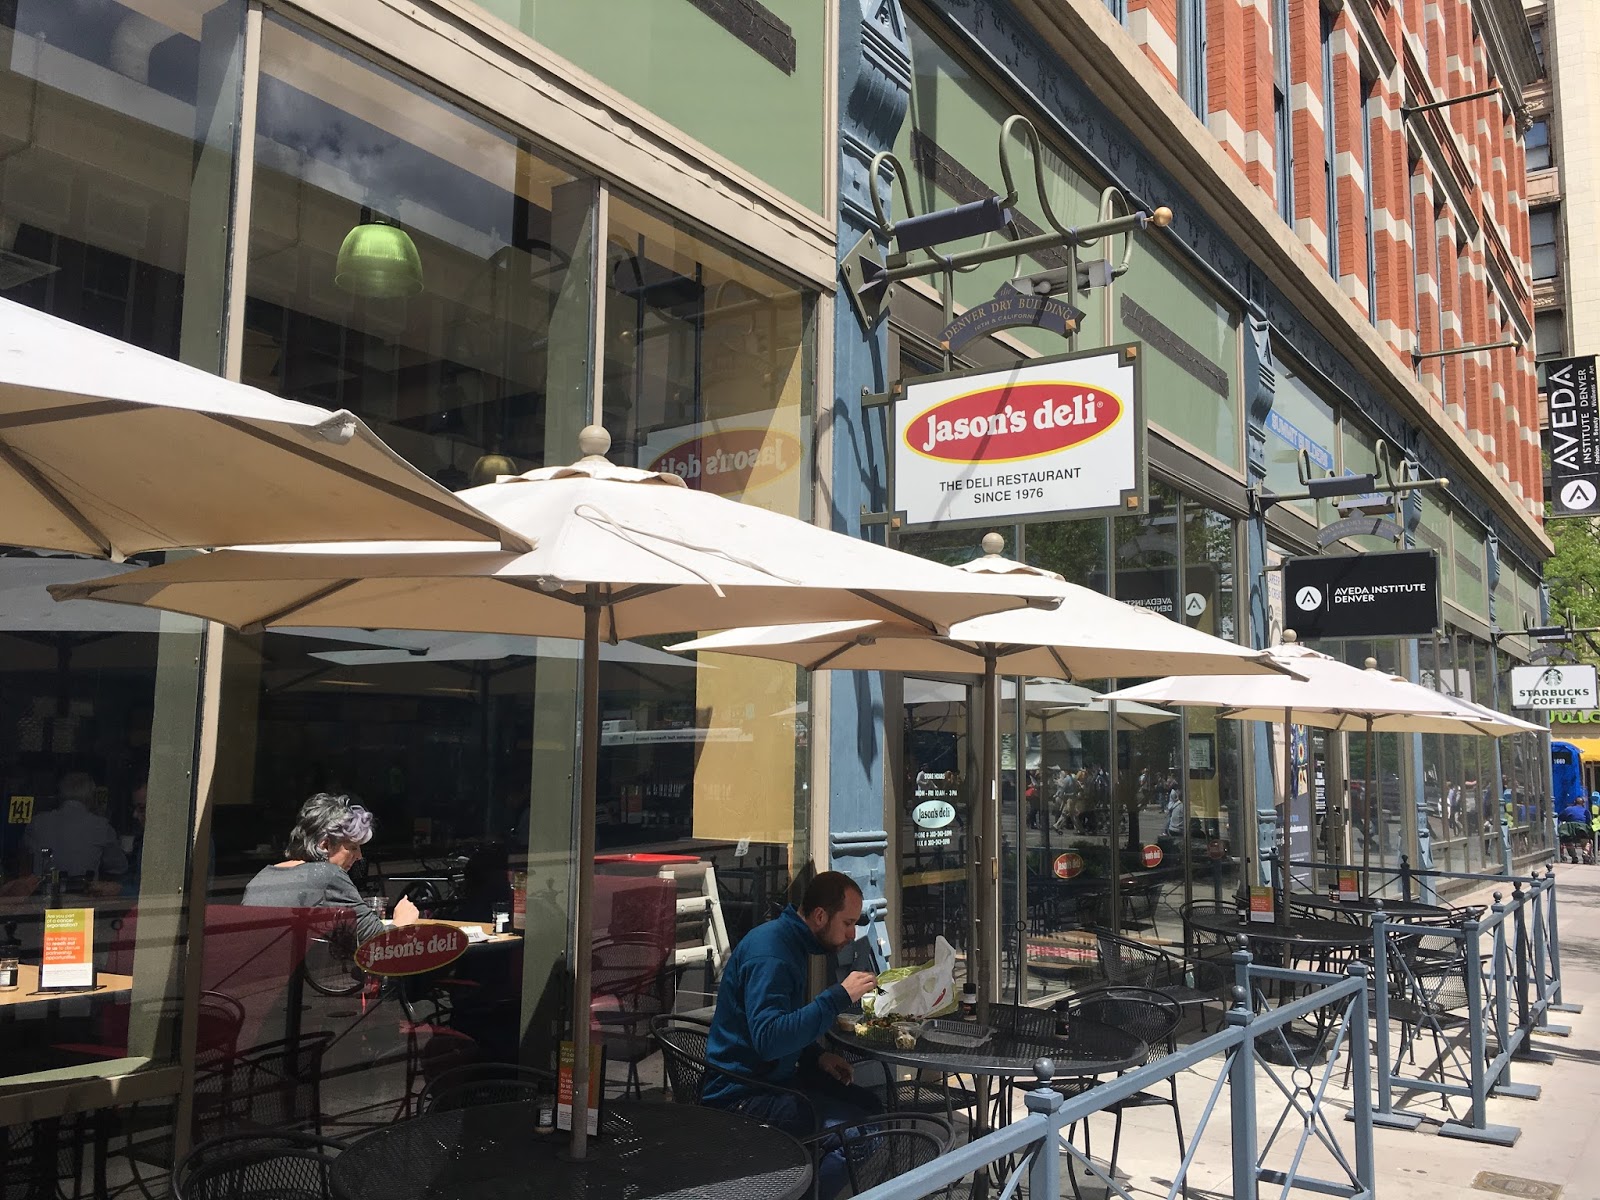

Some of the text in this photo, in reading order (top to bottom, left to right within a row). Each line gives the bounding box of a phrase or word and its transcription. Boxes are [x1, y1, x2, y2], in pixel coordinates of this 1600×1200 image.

[944, 298, 1073, 340] DENVER DRY BUILDING
[998, 313, 1039, 322] CALIFORNIA
[1548, 363, 1580, 471] AVEDA
[1578, 368, 1592, 464] INSTITUTE DENVER
[922, 405, 1027, 452] Jason's
[939, 467, 1081, 492] THE DELI RESTAURANT
[974, 488, 1044, 504] SINCE 1976
[1334, 583, 1426, 596] AVEDA INSTITUTE
[1334, 594, 1375, 604] DENVER
[1519, 688, 1589, 697] STARBUCKS
[12, 800, 31, 817] 141
[918, 807, 950, 822] Jason's deli
[366, 932, 458, 967] Jason's deli
